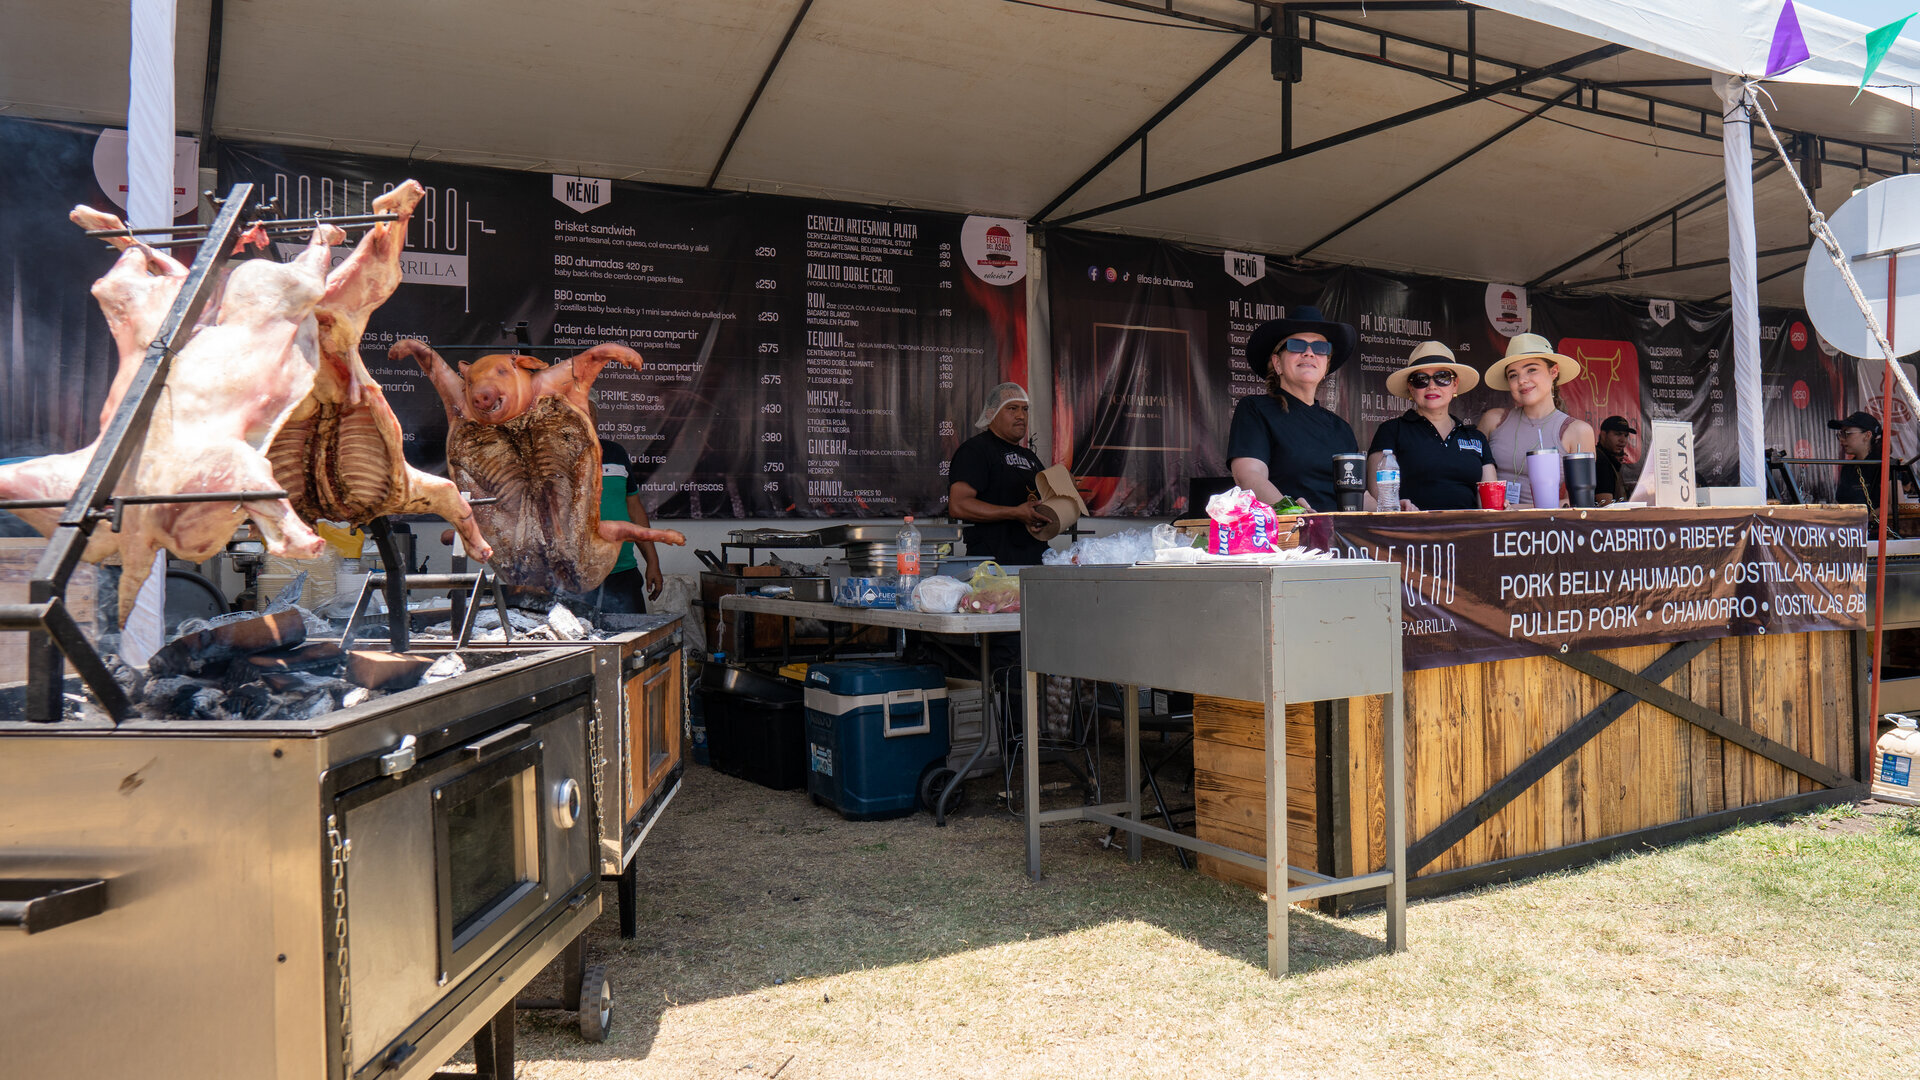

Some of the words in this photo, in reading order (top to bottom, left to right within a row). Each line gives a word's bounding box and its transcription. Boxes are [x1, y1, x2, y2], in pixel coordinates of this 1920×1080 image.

[566, 180, 599, 204] MENÚ
[554, 220, 589, 233] Brisket
[591, 224, 636, 236] sandwich
[807, 215, 844, 233] CERVEZA
[846, 218, 892, 237] ARTESANAL
[893, 222, 918, 239] PLATA
[754, 247, 777, 257] $250
[575, 256, 624, 269] ahumadas
[625, 262, 640, 270] 420
[641, 263, 654, 273] grs
[1233, 257, 1257, 278] MENÚ
[554, 268, 572, 277] baby
[572, 269, 589, 277] back
[590, 270, 603, 278] ribs
[603, 271, 613, 279] de
[614, 272, 633, 280] cerdo
[646, 274, 667, 283] papas
[667, 275, 683, 284] fritas
[807, 263, 840, 280] AZULITO
[843, 266, 869, 283] DOBLE
[872, 268, 893, 284] CERO
[1006, 270, 1013, 279] 7
[755, 279, 777, 290] $250
[574, 292, 607, 302] combo
[807, 292, 826, 308] RON
[757, 311, 779, 322] $250
[1243, 302, 1253, 320] EL
[554, 323, 582, 334] Orden
[583, 324, 596, 335] de
[597, 325, 628, 336] lechón
[629, 328, 652, 339] para
[653, 329, 699, 340] compartir
[1230, 321, 1245, 331] Taco
[1374, 316, 1387, 332] LOS
[1388, 317, 1432, 337] HUERQUILLOS
[807, 330, 844, 349] TEQUILA
[1230, 333, 1246, 343] Taco
[1360, 333, 1384, 344] Papitas
[758, 343, 779, 353] $575
[1230, 346, 1246, 356] Taco
[1230, 359, 1246, 369] Taco
[1360, 353, 1384, 364] Papitas
[1395, 357, 1409, 365] fran
[1650, 360, 1663, 370] TACO
[657, 362, 703, 373] compartir
[760, 374, 782, 385] $575
[1231, 372, 1247, 382] Taco
[382, 381, 415, 392] marón
[1231, 384, 1247, 394] Taco
[600, 390, 629, 401] PRIME
[630, 393, 646, 402] 350
[646, 395, 660, 403] grs
[807, 390, 839, 407] WHISKY
[1652, 388, 1668, 398] PLATO
[1669, 389, 1676, 398] DE
[760, 403, 782, 414] $430
[1375, 394, 1385, 411] EL
[597, 421, 615, 431] ado
[617, 423, 633, 432] 350
[633, 424, 646, 433] grs
[761, 432, 782, 442] $380
[808, 439, 847, 456] GINEBRA
[638, 454, 650, 463] de
[651, 455, 667, 464] res
[763, 462, 784, 473] $750
[1677, 432, 1690, 502] CAJA
[641, 482, 678, 492] natural,
[679, 482, 724, 492] refrescos
[763, 481, 779, 492] $45
[808, 480, 843, 497] BRANDY
[1493, 530, 1575, 557] LECHON
[1590, 527, 1666, 553] CABRITO
[1680, 526, 1735, 549] RIBEYE
[1750, 526, 1786, 546] NEW
[1788, 526, 1828, 548] YORK
[1837, 528, 1868, 548] SIRL
[1404, 543, 1456, 607] CERO
[1500, 573, 1554, 600] PORK
[1559, 571, 1614, 597] BELLY
[1618, 565, 1703, 592] AHUMADO
[1724, 562, 1812, 584] COSTILLAR
[1509, 609, 1582, 638] PULLED
[1588, 604, 1639, 630] PORK
[1661, 595, 1757, 625] CHAMORRO
[1775, 593, 1843, 617] COSTILLAS
[1846, 593, 1867, 614] BB
[1401, 618, 1457, 636] PARRILLA
